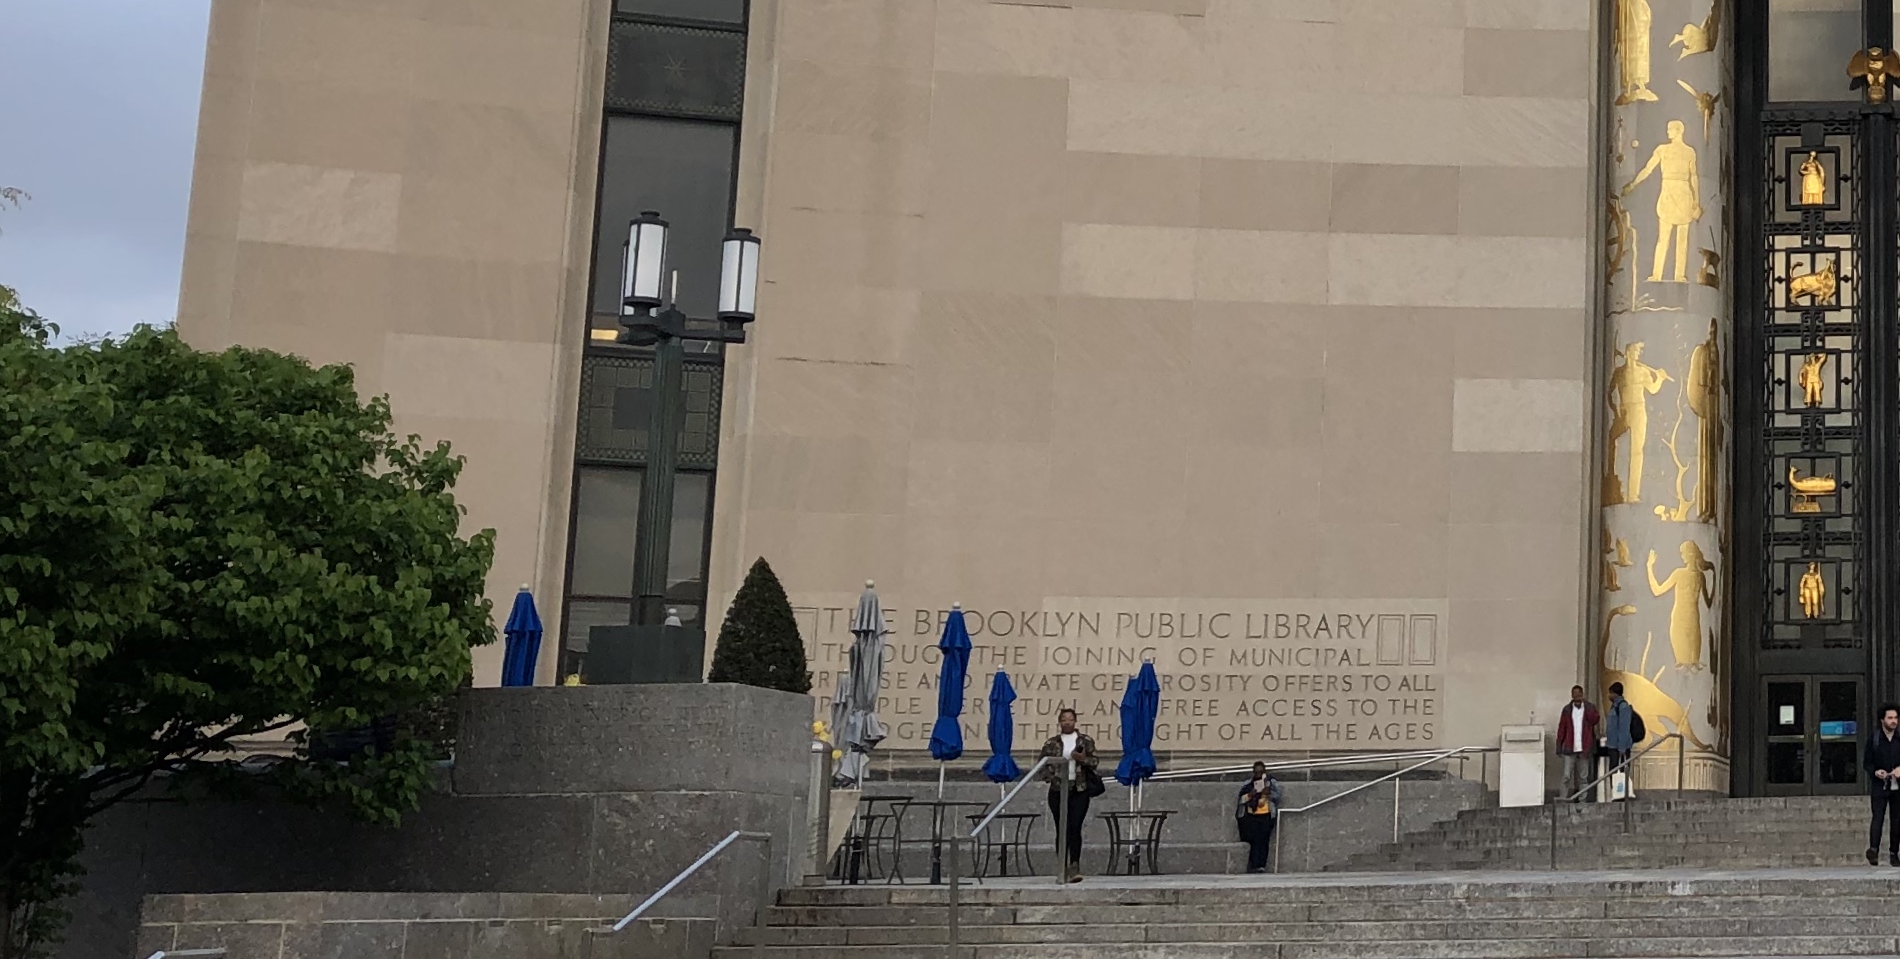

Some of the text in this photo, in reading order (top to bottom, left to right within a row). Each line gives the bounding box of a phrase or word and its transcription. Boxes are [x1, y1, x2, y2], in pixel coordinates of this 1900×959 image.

[1115, 611, 1232, 639] PUBLIC
[1245, 612, 1375, 640] LIBRARY
[821, 643, 1371, 668] THOUG THE JOINING OF MUNICIPAL
[984, 672, 1081, 691] PIVATE
[1091, 673, 1254, 693] GEROSITY
[1262, 674, 1353, 693] OFFERS
[1361, 674, 1392, 693] TO
[1398, 674, 1437, 692] ALL
[819, 696, 923, 715] PPLE
[1092, 698, 1121, 717] AN
[1160, 698, 1220, 718] FREE
[1235, 699, 1339, 718] ACCESS
[1347, 698, 1379, 717] TO
[1387, 698, 1435, 717] THE
[1080, 722, 1209, 742] THGHT
[1218, 723, 1252, 742] OF
[1260, 723, 1303, 741] ALL
[1310, 723, 1358, 741] THE
[1367, 723, 1435, 742] AGES
